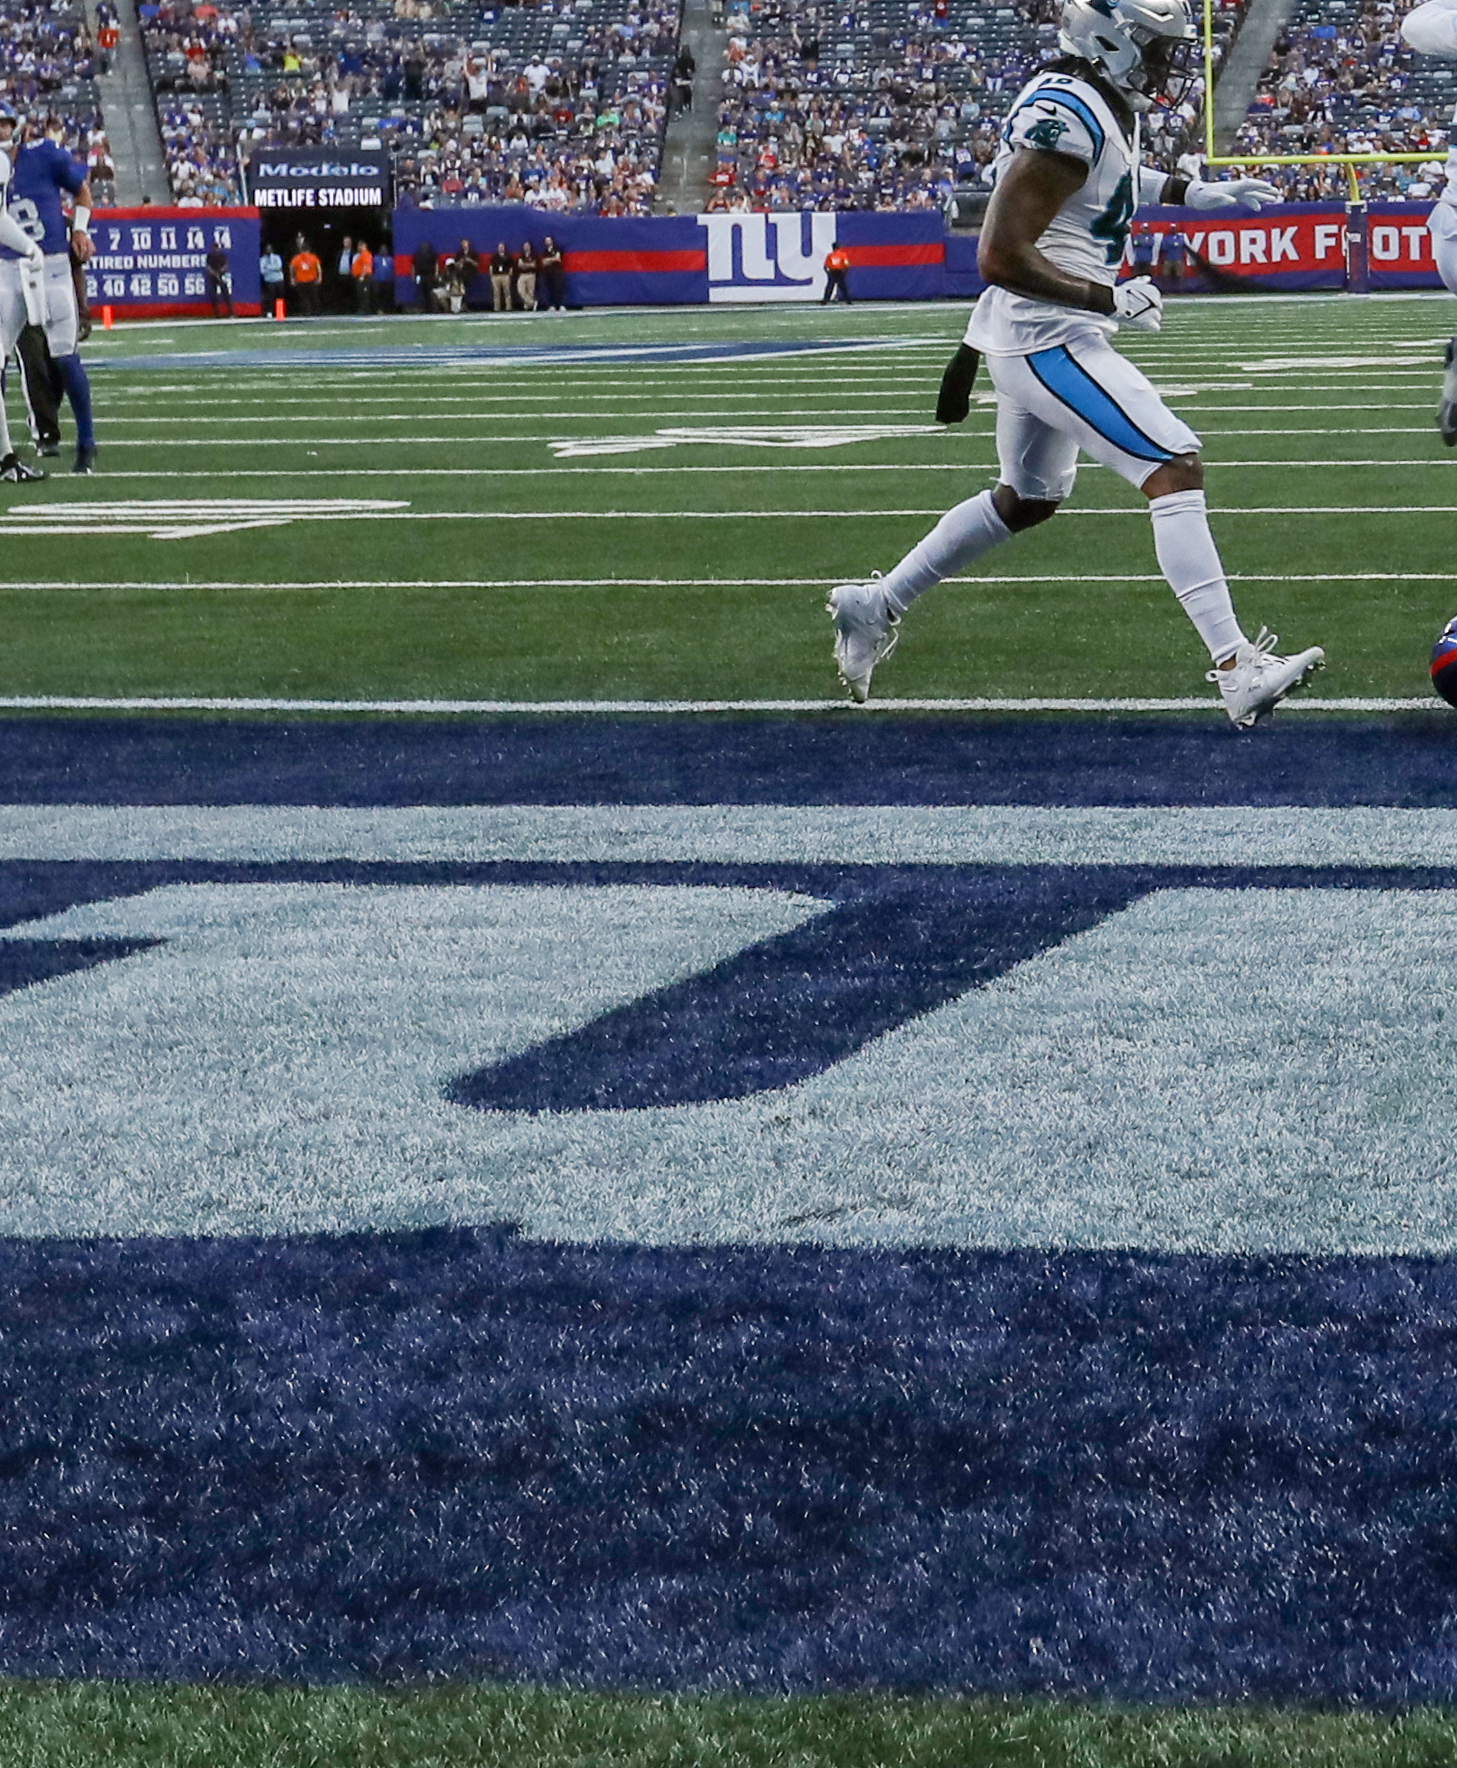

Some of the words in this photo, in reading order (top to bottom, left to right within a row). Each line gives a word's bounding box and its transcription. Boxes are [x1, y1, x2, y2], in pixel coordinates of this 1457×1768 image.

[258, 162, 380, 177] Modelo
[254, 188, 316, 208] METLIFE
[318, 187, 382, 207] STADIUM
[132, 230, 152, 250] 10
[160, 230, 177, 250] 11
[187, 230, 205, 250] 14
[1185, 224, 1299, 267] YORK
[137, 254, 208, 270] NUMBERS
[696, 212, 837, 303] ny
[103, 278, 125, 297] 40
[157, 278, 180, 297] 50
